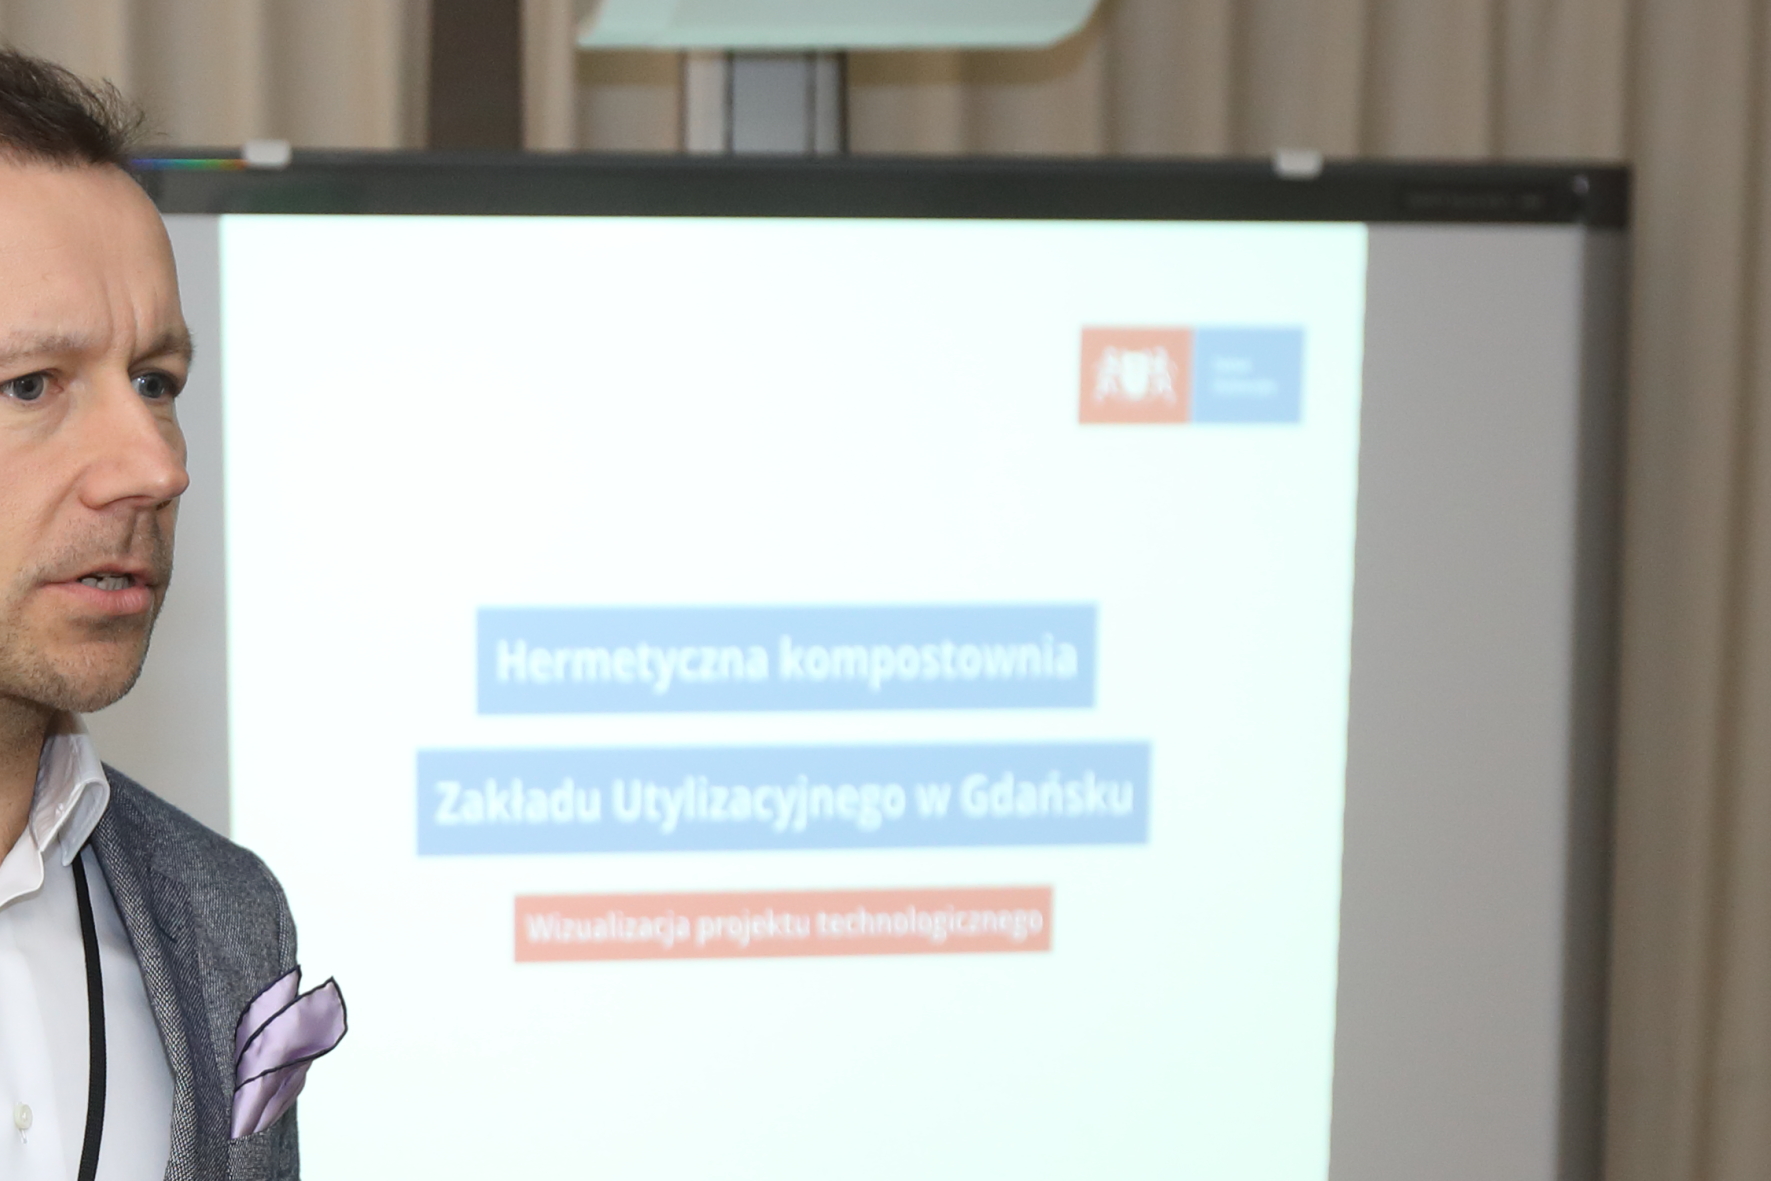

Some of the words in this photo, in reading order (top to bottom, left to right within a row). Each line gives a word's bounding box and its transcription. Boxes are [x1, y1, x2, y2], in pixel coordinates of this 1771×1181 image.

[494, 637, 770, 696] Hermetyczna
[777, 632, 1079, 692] kompostownia
[432, 776, 603, 827] Zakładu
[610, 773, 907, 836] Utylizacyjnego
[914, 784, 953, 819] w
[959, 769, 1134, 817] Gdańsku
[524, 911, 691, 950] Wizualizacja
[695, 909, 811, 950] projektu
[816, 904, 1044, 946] technologicznego
